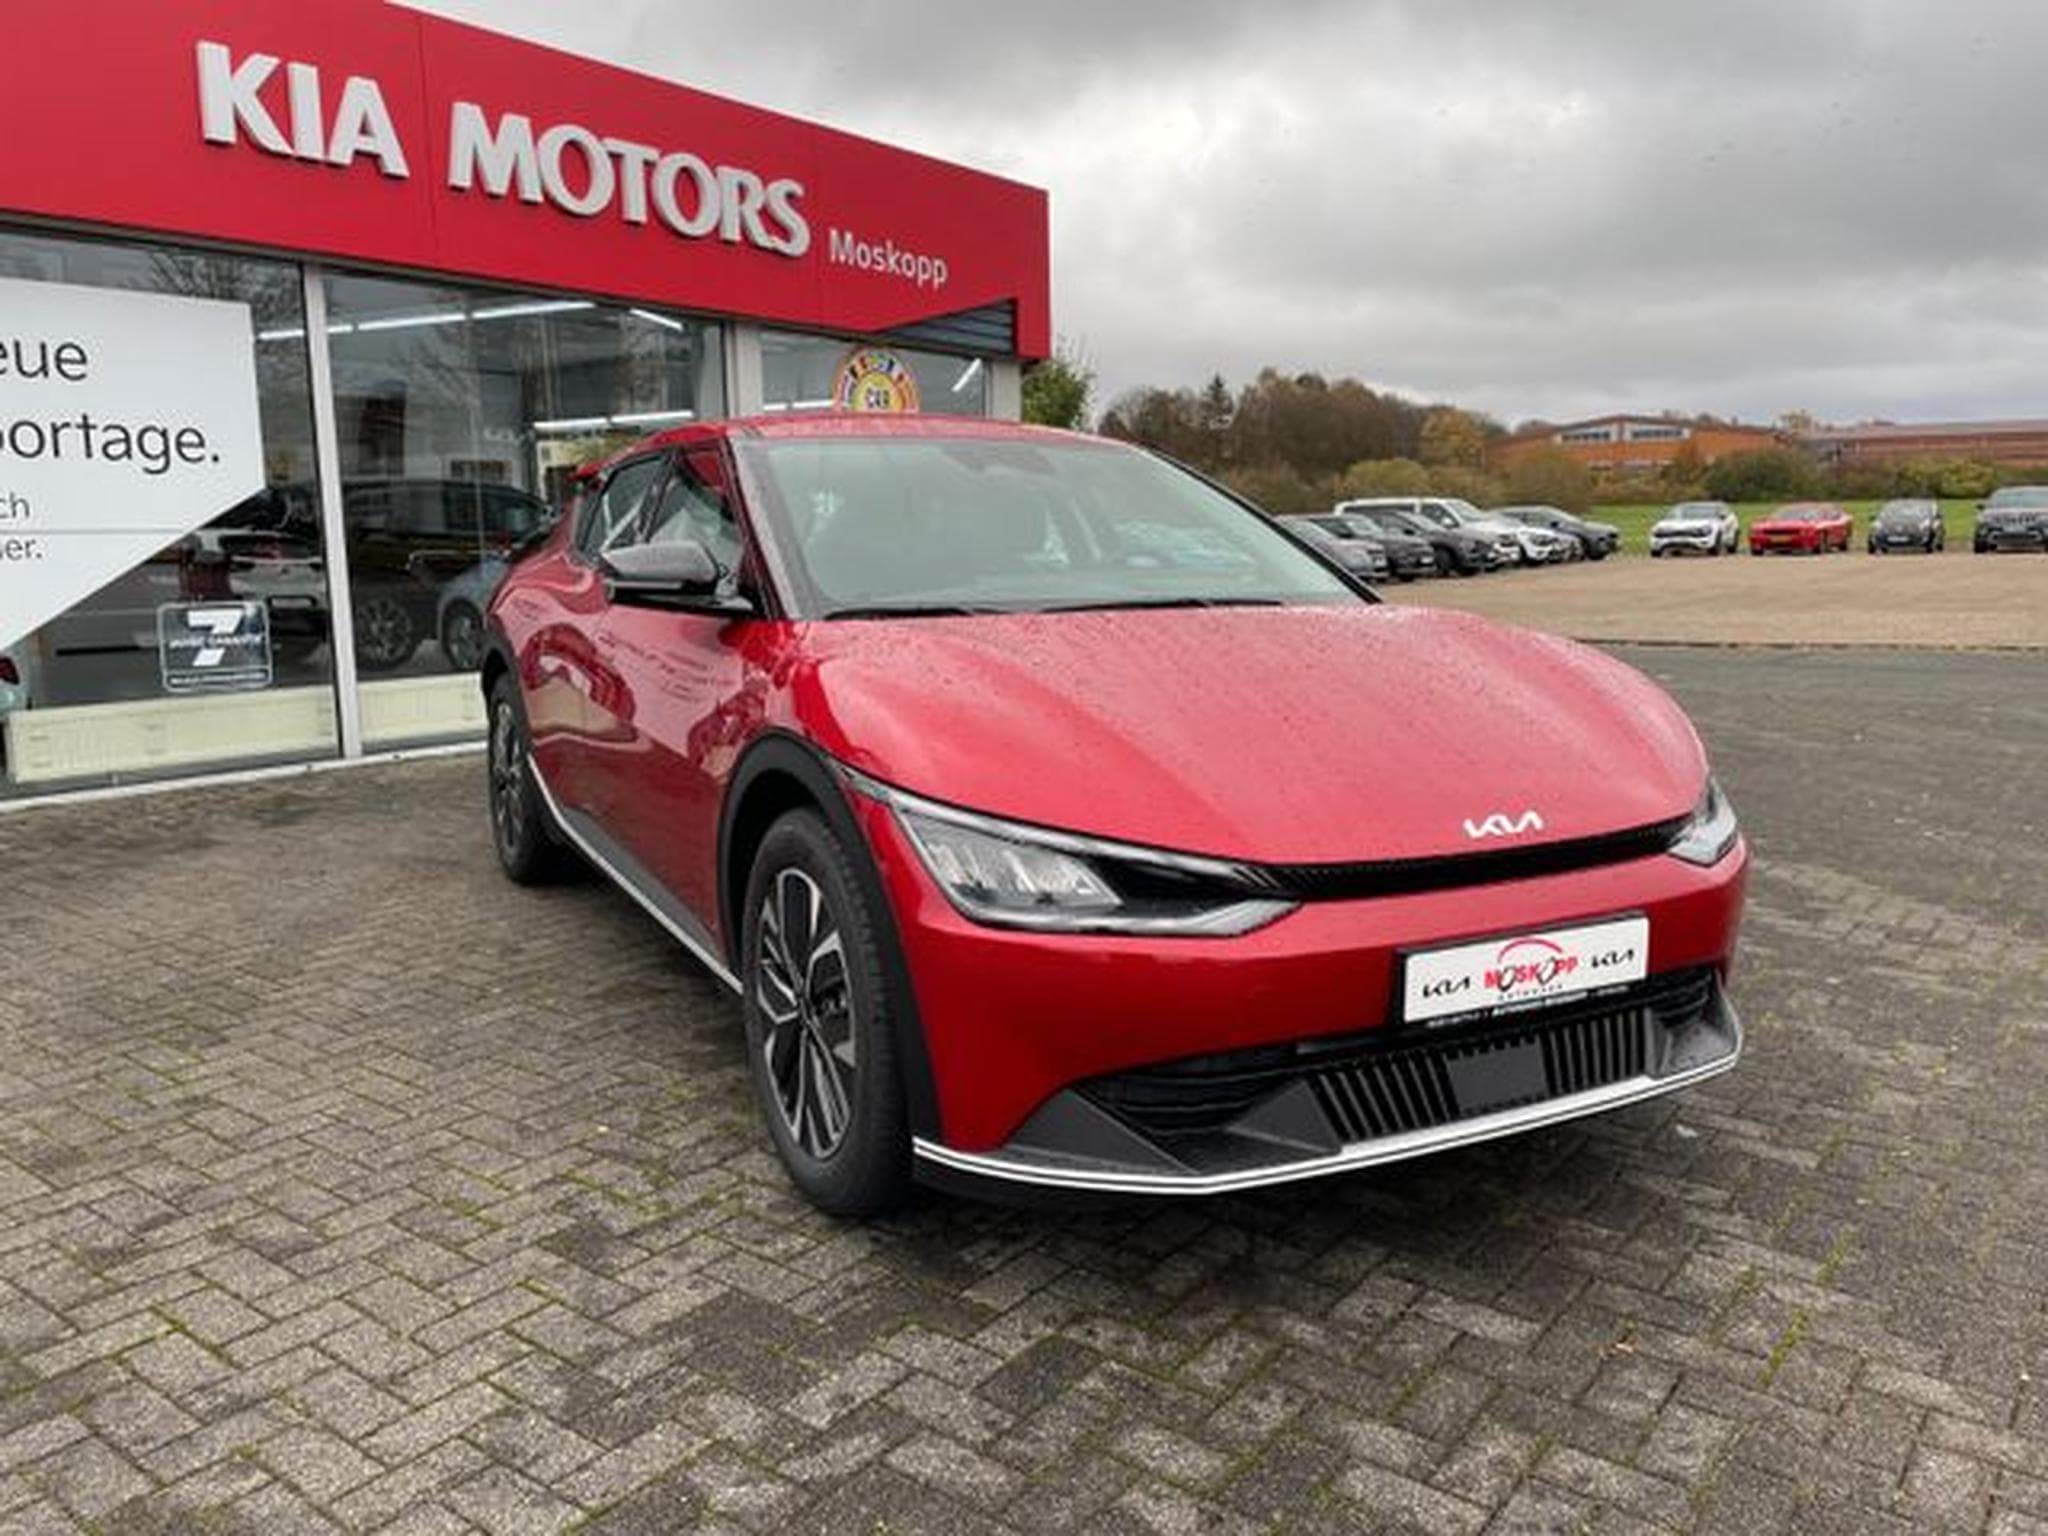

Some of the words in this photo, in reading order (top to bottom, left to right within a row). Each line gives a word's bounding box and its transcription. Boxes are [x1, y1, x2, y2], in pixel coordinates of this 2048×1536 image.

[197, 40, 409, 178] KIA
[448, 101, 811, 257] MOTORS
[829, 227, 948, 289] Moskopp
[0, 413, 220, 475] ortage.
[0, 539, 43, 561] er.
